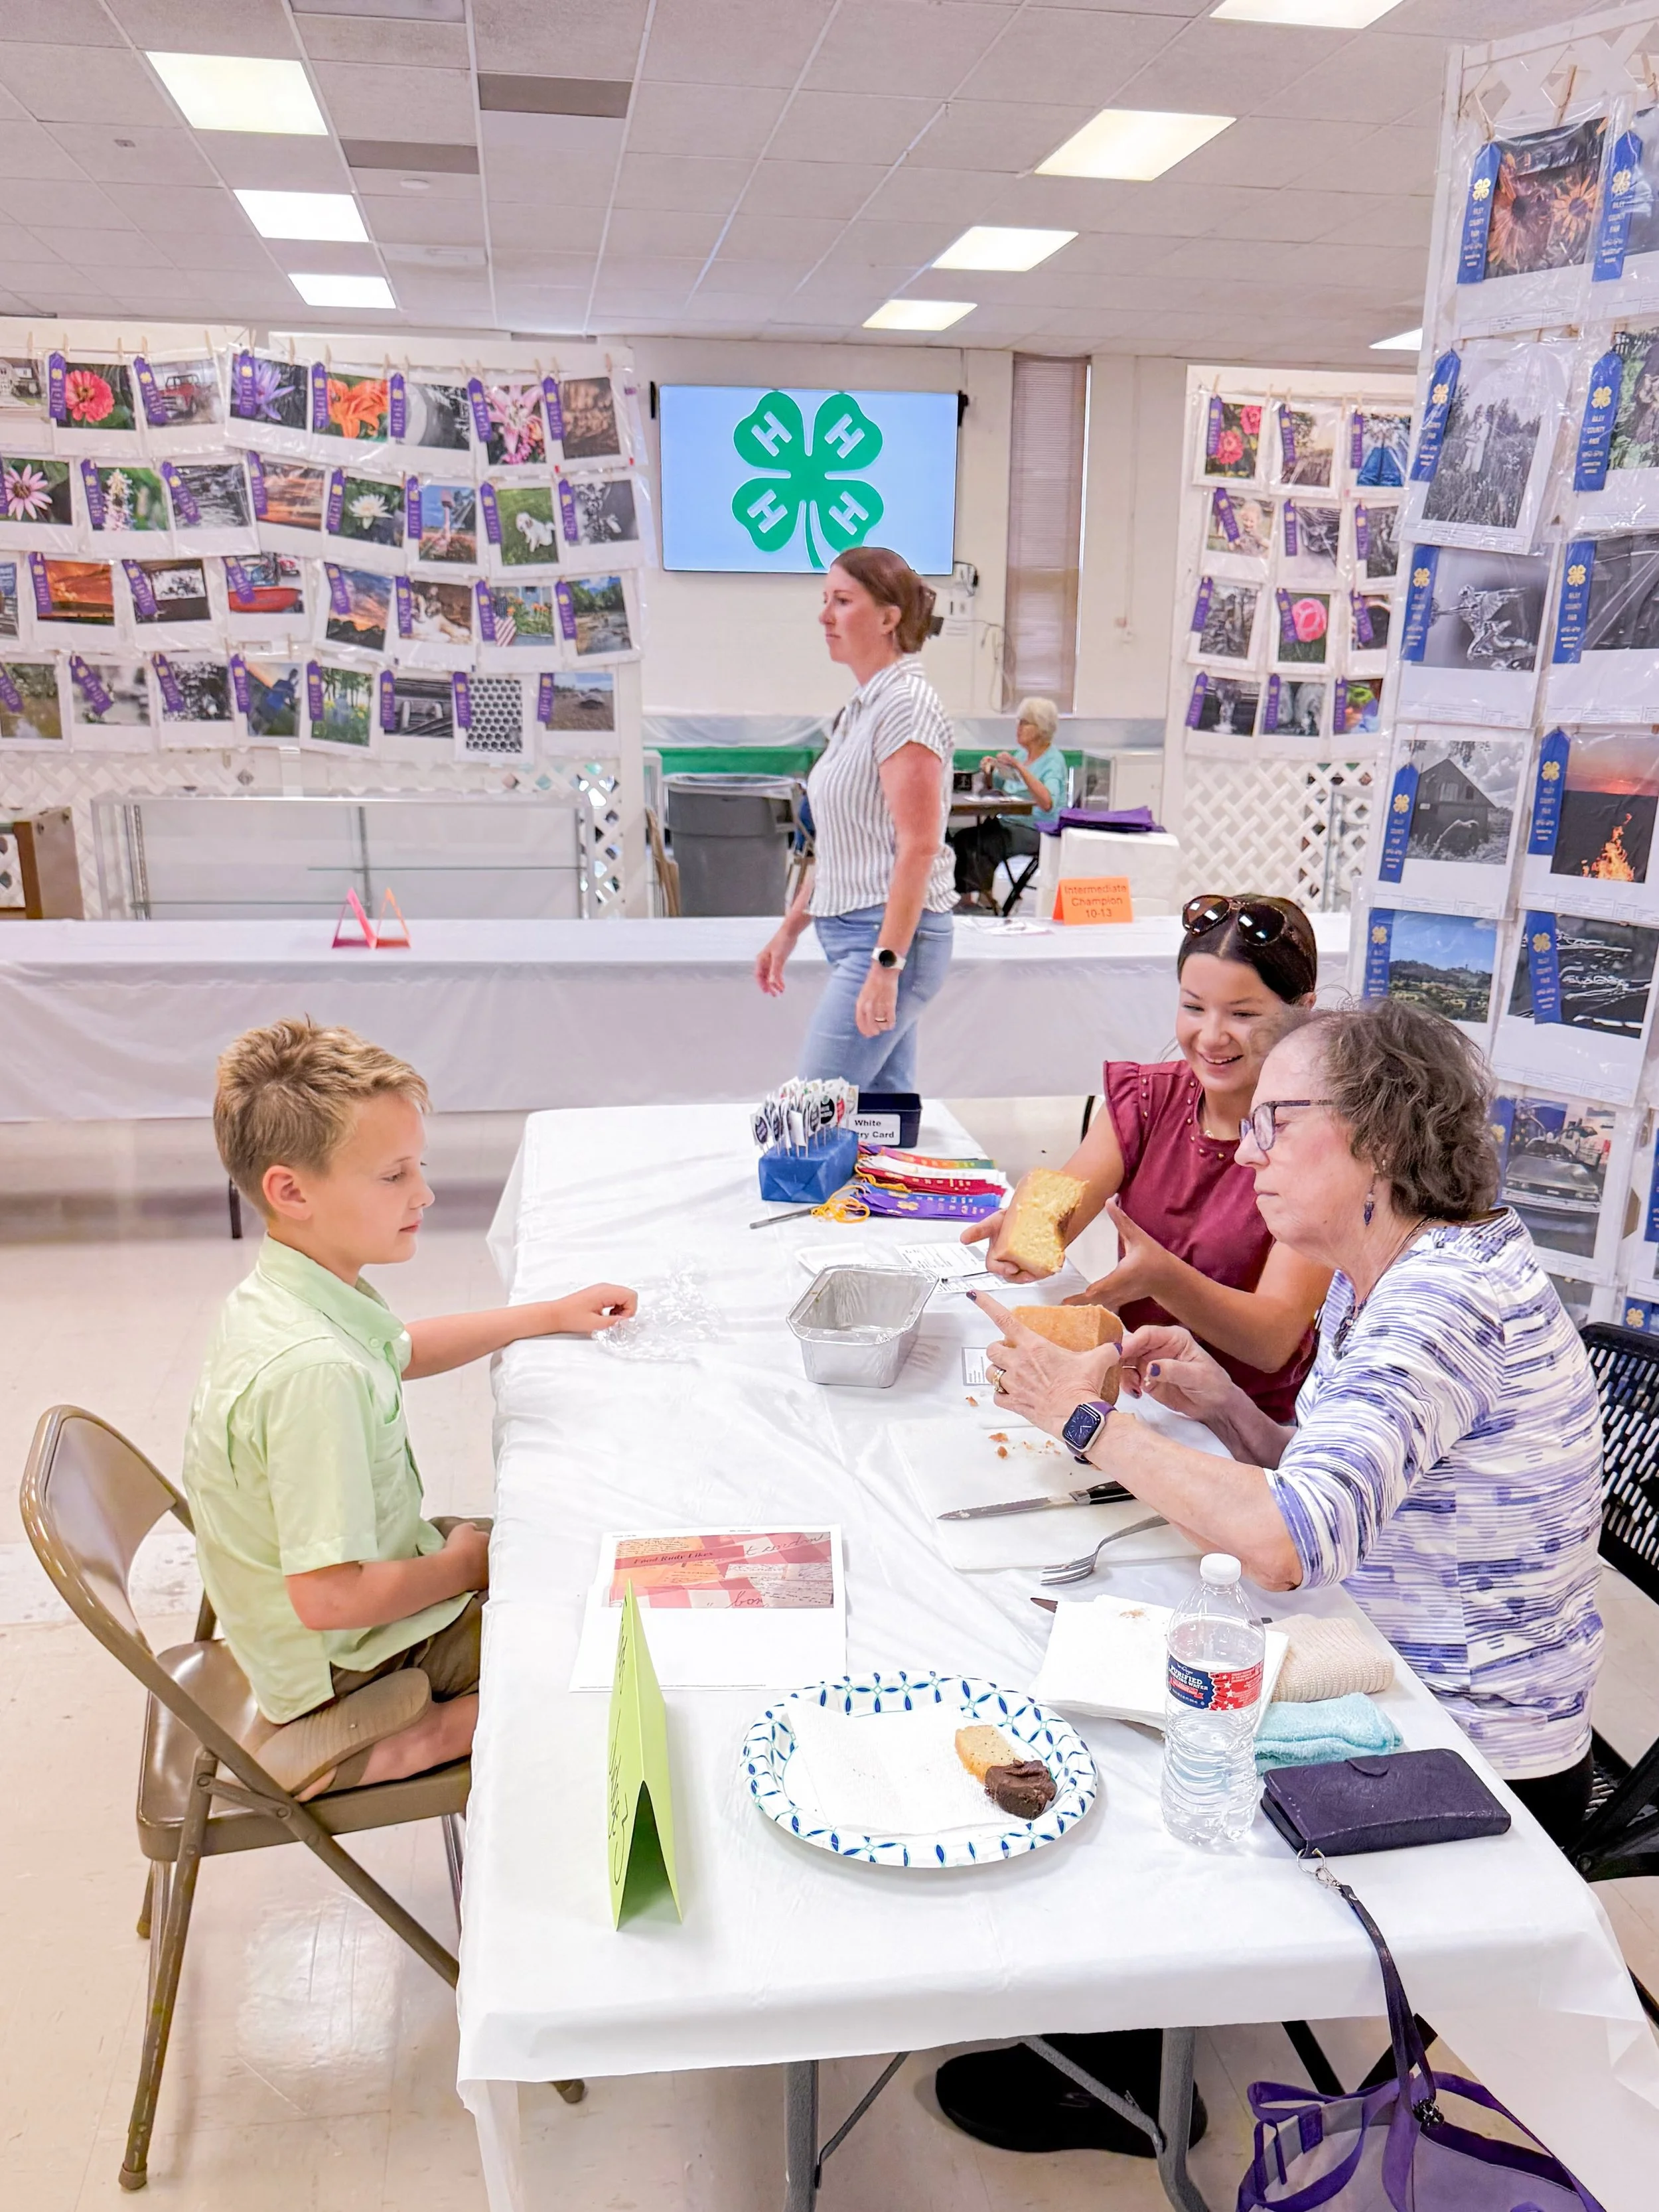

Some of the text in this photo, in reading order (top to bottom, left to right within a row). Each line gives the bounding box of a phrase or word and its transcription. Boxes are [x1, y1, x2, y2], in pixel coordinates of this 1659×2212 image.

[751, 411, 792, 457] H
[824, 413, 865, 459] H
[747, 489, 788, 534] H
[829, 491, 869, 536] H
[1064, 885, 1127, 895] Intermediate
[1072, 897, 1123, 907] Champion
[1086, 909, 1112, 918] 10-13
[1188, 1681, 1208, 1691] WATER
